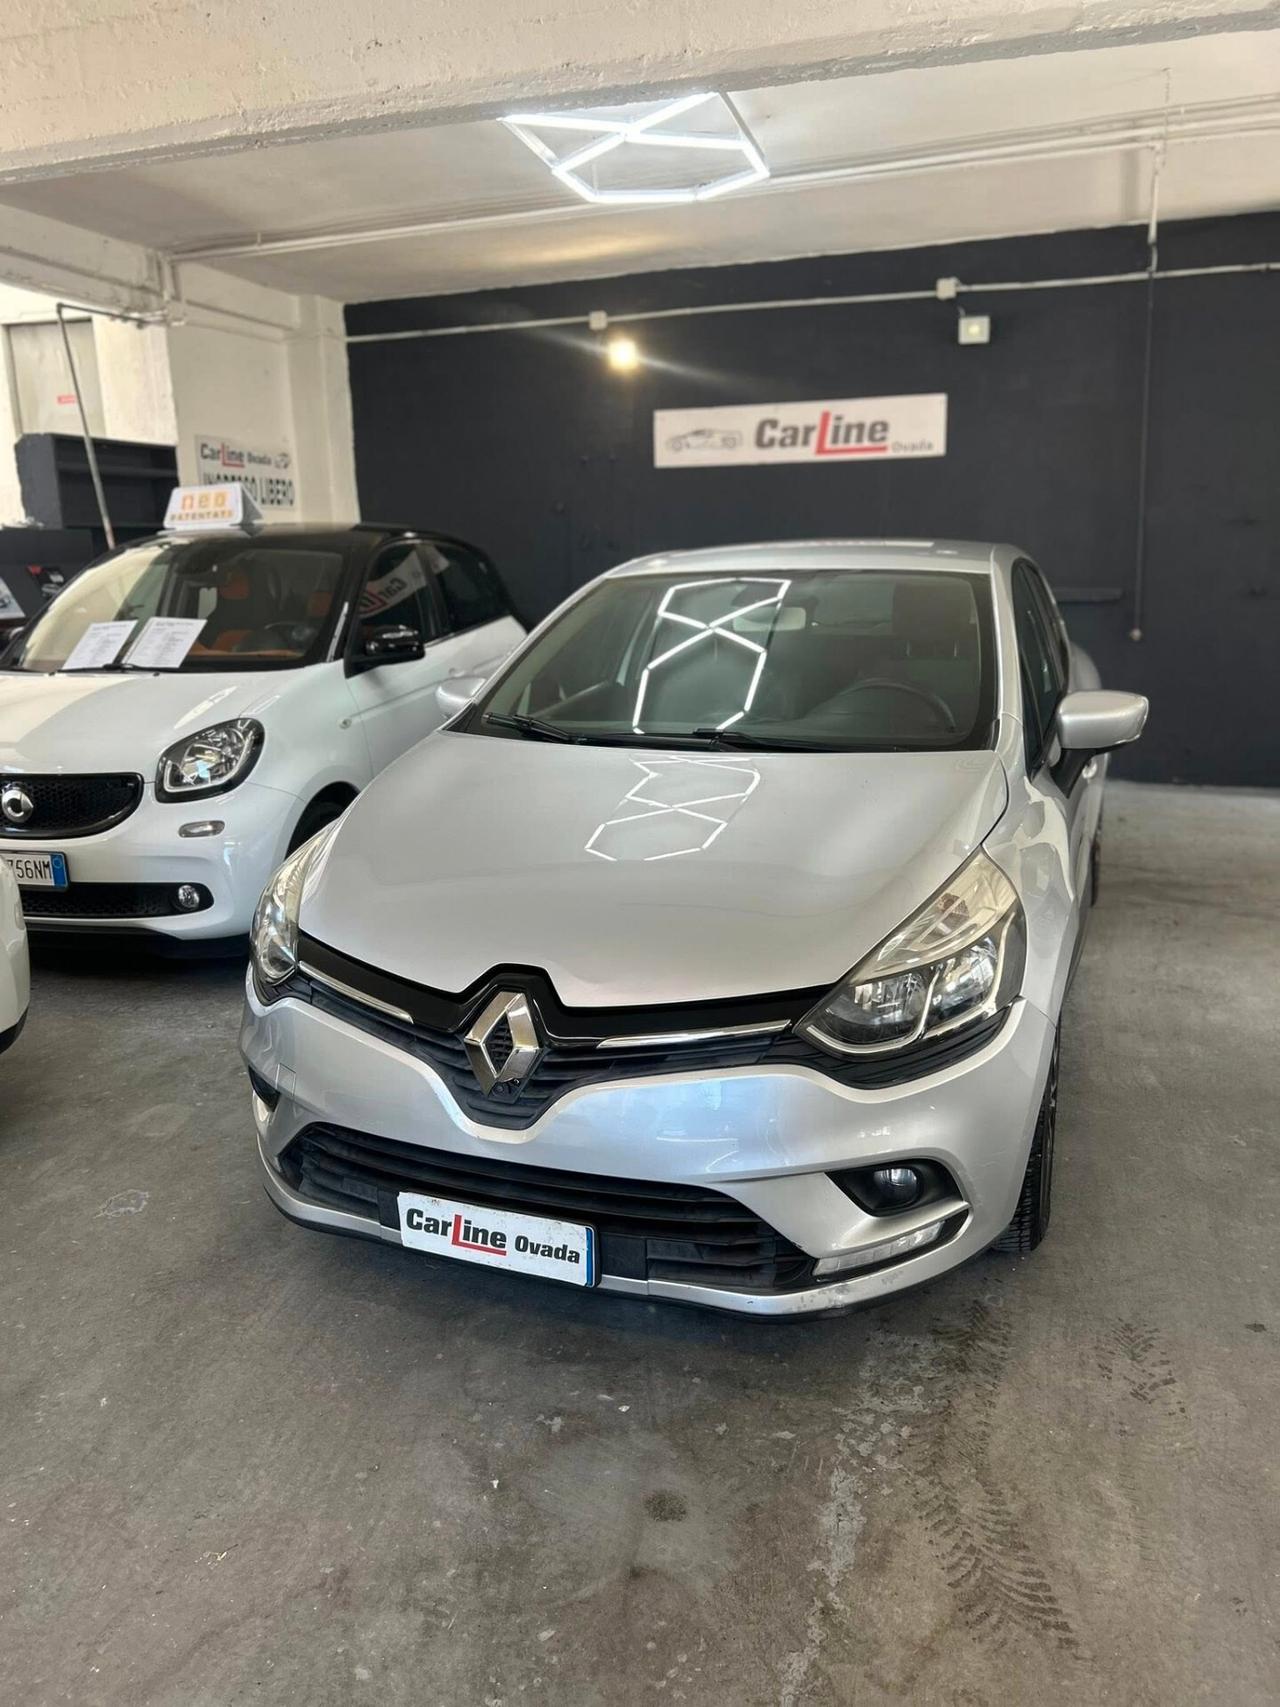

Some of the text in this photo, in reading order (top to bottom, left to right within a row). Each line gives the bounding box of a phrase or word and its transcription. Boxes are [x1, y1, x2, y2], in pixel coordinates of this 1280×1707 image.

[755, 410, 889, 455] CarLine
[201, 442, 245, 468] CarLine
[260, 477, 295, 507] LIBERO
[406, 1208, 580, 1265] CarLine Ovada
